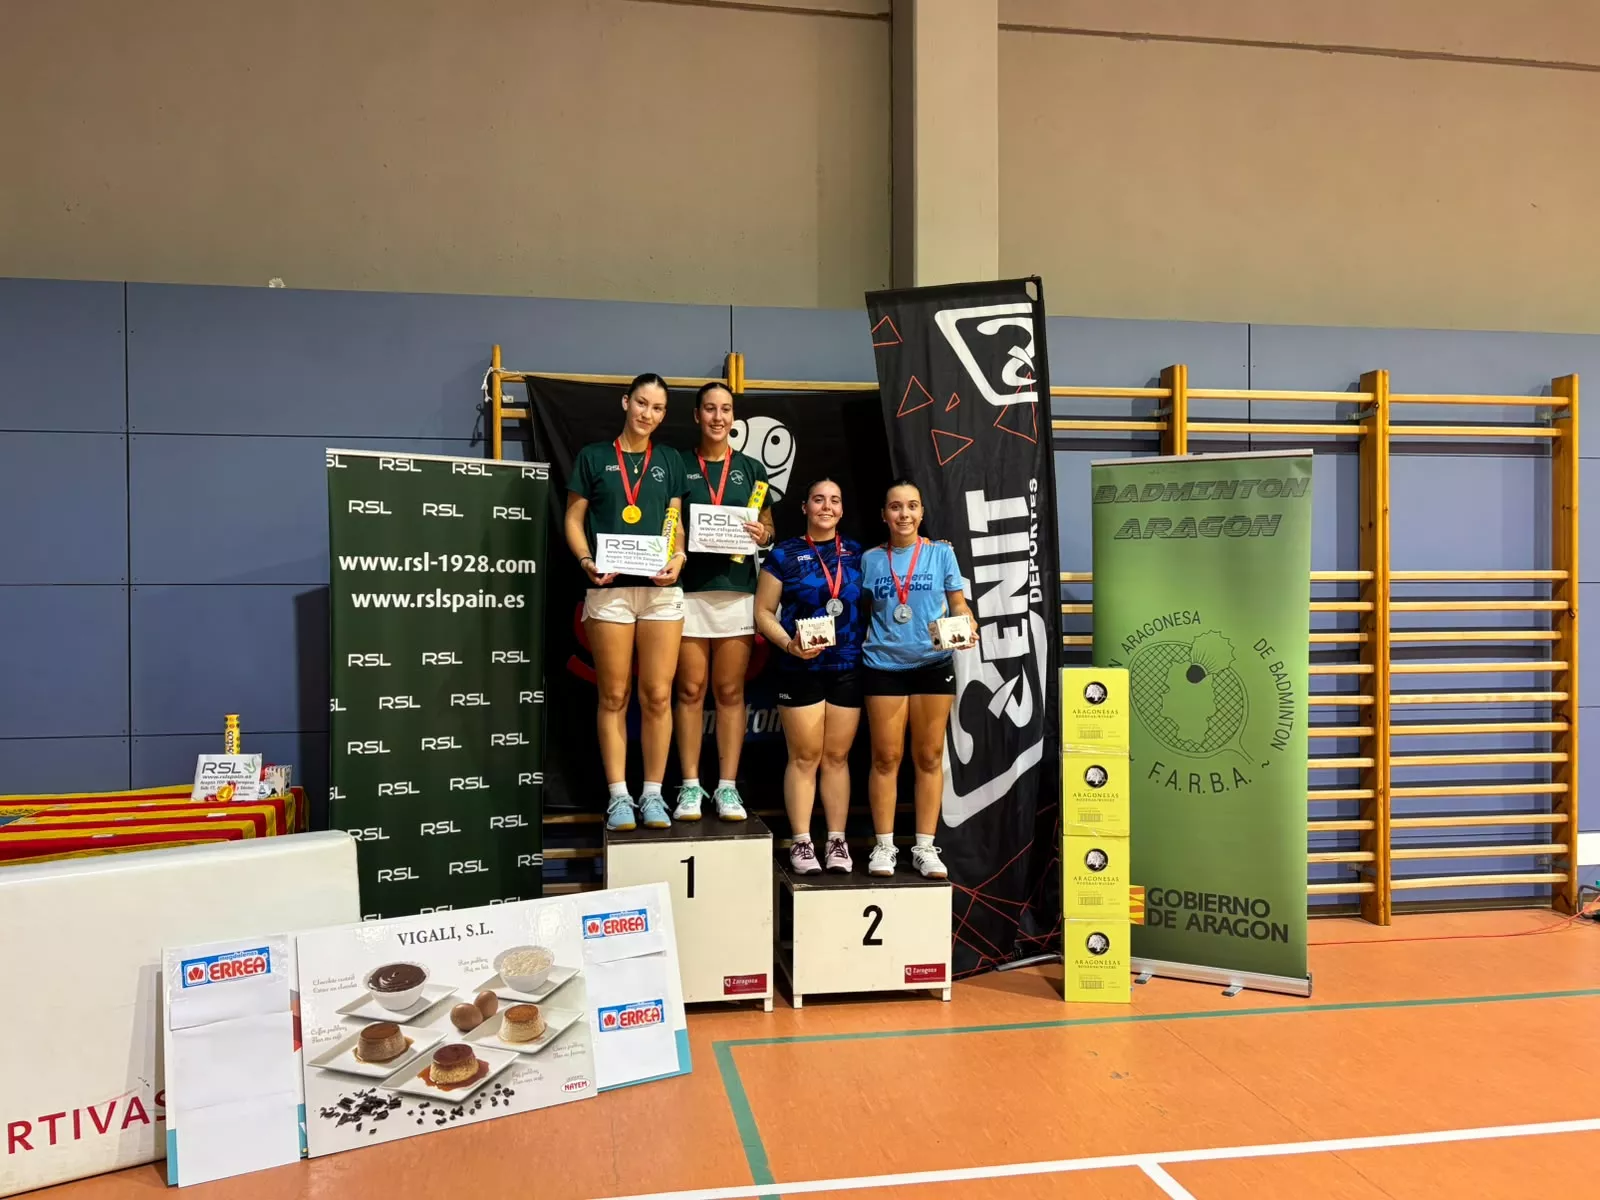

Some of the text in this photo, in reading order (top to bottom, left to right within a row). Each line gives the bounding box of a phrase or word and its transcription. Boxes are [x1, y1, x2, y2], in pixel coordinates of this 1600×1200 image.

[380, 458, 422, 472] RSL
[452, 462, 492, 476] RSL
[1093, 477, 1310, 504] BADMINTON
[348, 500, 532, 520] RSL RSL RSL
[698, 513, 738, 527] RSL
[1114, 514, 1282, 540] ARAGON
[605, 539, 647, 551] RSL
[1029, 478, 1043, 604] DEPORTES
[338, 552, 536, 574] www.rsl-1928.com
[797, 554, 814, 562] RSL
[352, 588, 525, 612] www.rslspain.es
[348, 651, 530, 667] RSL RSL RSL
[1120, 610, 1295, 752] ARAGONESA DE BADMINTON
[379, 695, 421, 710] RSL
[450, 693, 490, 707] RSL
[348, 732, 529, 755] RSL RSL RSL
[202, 762, 241, 774] RSL
[1148, 761, 1252, 794] F.A.R.B.A.
[378, 781, 420, 796] RSL
[450, 776, 489, 791] RSL
[346, 814, 528, 841] RSL RSL RSL
[378, 867, 419, 883] RSL
[449, 860, 489, 875] RSL
[680, 856, 695, 898] 1
[1147, 888, 1270, 918] GOBIERNO
[396, 923, 494, 946] VIGALI, S.L.
[604, 917, 644, 935] ERREA
[862, 905, 883, 946] 2
[1147, 908, 1288, 943] DE ARAGON
[210, 956, 265, 980] ERREA
[620, 1007, 660, 1027] ERREA
[564, 1080, 588, 1090] NAYEM
